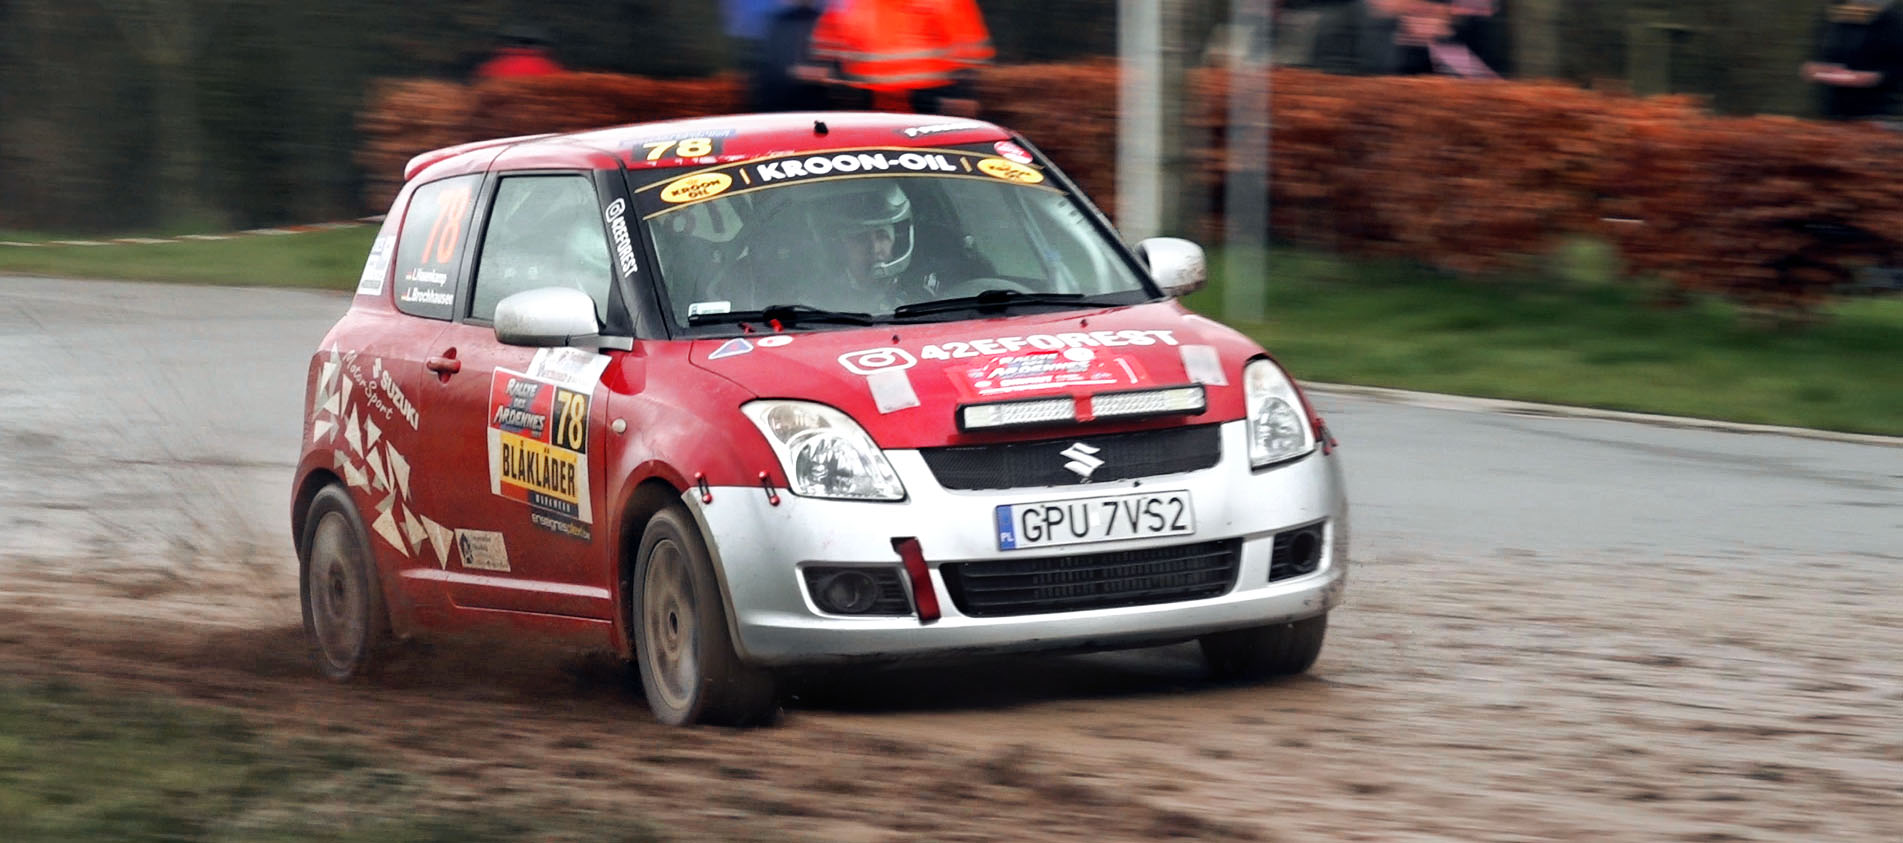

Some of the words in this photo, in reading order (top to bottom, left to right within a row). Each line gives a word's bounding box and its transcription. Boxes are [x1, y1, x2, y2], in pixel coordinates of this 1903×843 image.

[642, 137, 712, 161] 78
[756, 153, 957, 182] KROON-OIL
[671, 179, 720, 197] KROON
[687, 189, 710, 198] OIL
[421, 186, 472, 264] 78
[610, 216, 638, 278] 42EFOREST
[920, 330, 1180, 361] 42EFOREST
[381, 370, 419, 431] SUZUKI
[505, 378, 538, 398] RALLYE
[493, 405, 546, 431] ARDENNES
[557, 389, 586, 450] 78
[502, 440, 576, 497] BLÅKLÄDER
[1021, 503, 1090, 543] GPU
[1102, 497, 1187, 536] 7VS2
[1000, 532, 1014, 542] PL
